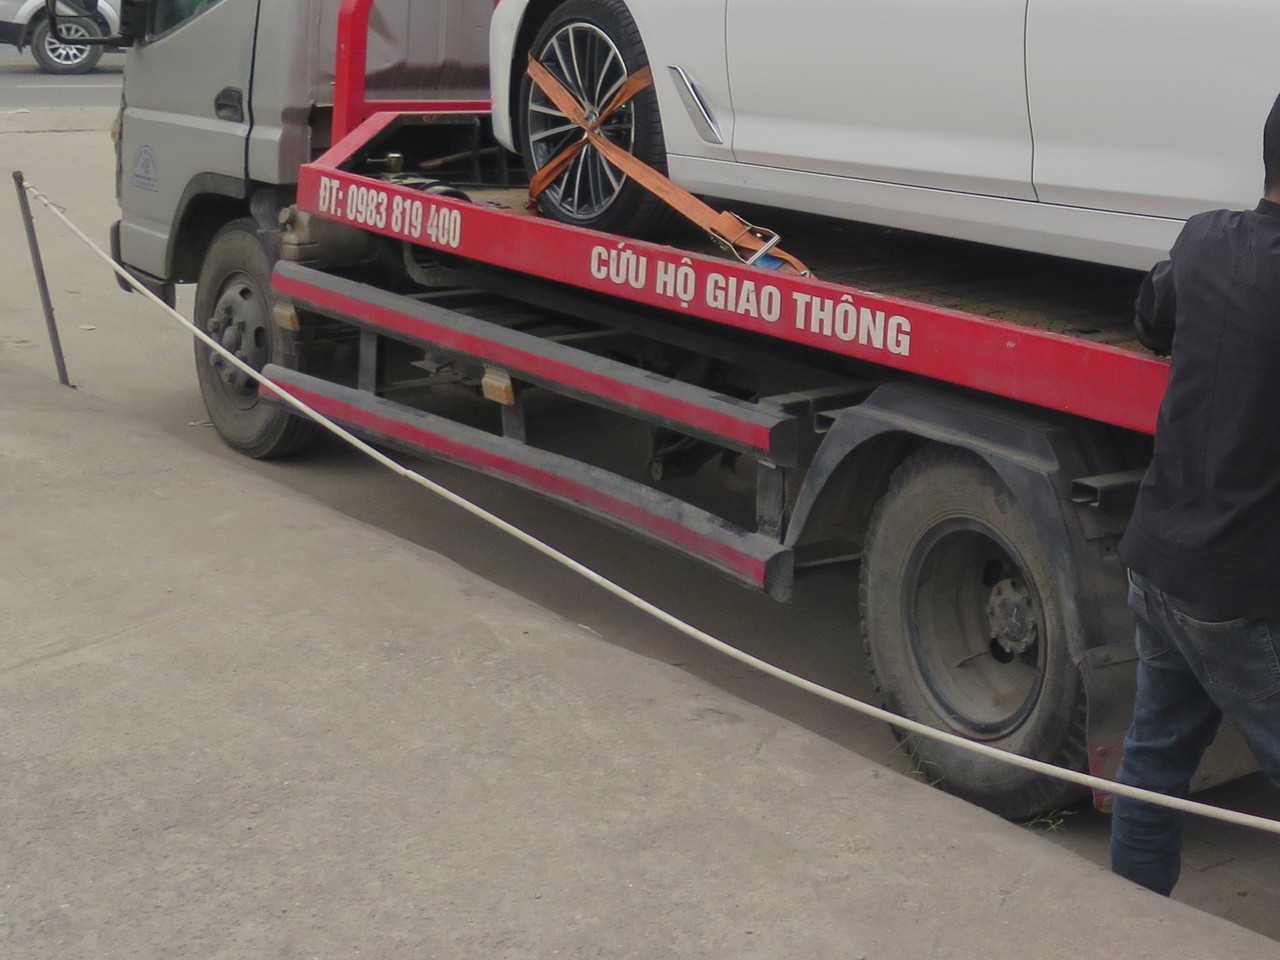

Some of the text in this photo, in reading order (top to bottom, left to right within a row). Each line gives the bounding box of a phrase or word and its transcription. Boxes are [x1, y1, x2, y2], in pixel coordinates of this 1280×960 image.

[318, 176, 462, 248] ĐT: 0983 819 400
[590, 242, 912, 357] CỨU HỘ GIAO THÔNG
